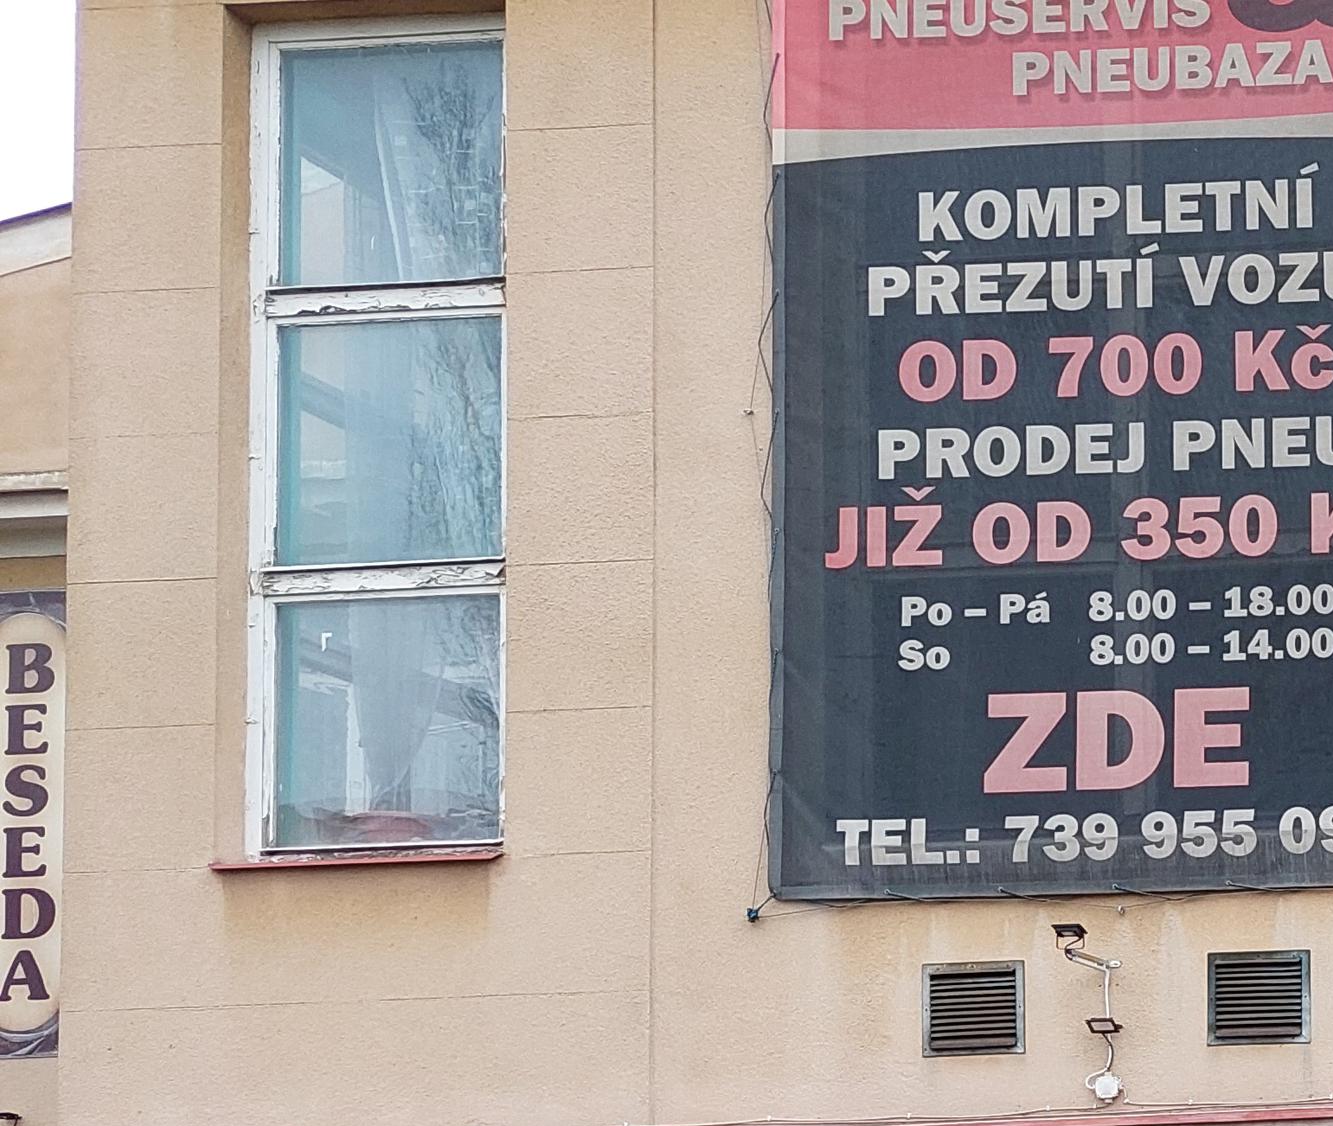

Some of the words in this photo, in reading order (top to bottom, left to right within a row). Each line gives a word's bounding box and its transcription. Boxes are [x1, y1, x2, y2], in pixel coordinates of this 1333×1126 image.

[829, 0, 1211, 41] PNEUSERVIS
[918, 162, 1319, 242] KOMPLETNÍ
[867, 242, 1159, 316] PŘEZUTÍ
[899, 340, 1017, 402] OD
[1048, 333, 1202, 397] 700
[877, 416, 1146, 480] PRODEJ
[824, 486, 943, 569] JIŽ
[971, 501, 1092, 564] OD
[1120, 494, 1278, 560] 350
[901, 596, 952, 627] Po
[1000, 592, 1051, 624] Pá
[1088, 589, 1176, 622] 8.00
[898, 640, 950, 671] So
[1089, 633, 1176, 666] 8.00
[983, 686, 1250, 793] ZDE
[1, 643, 57, 1001] BESEDA
[836, 818, 981, 866] TEL.:
[1004, 814, 1118, 863] 739
[1142, 808, 1257, 859] 955
